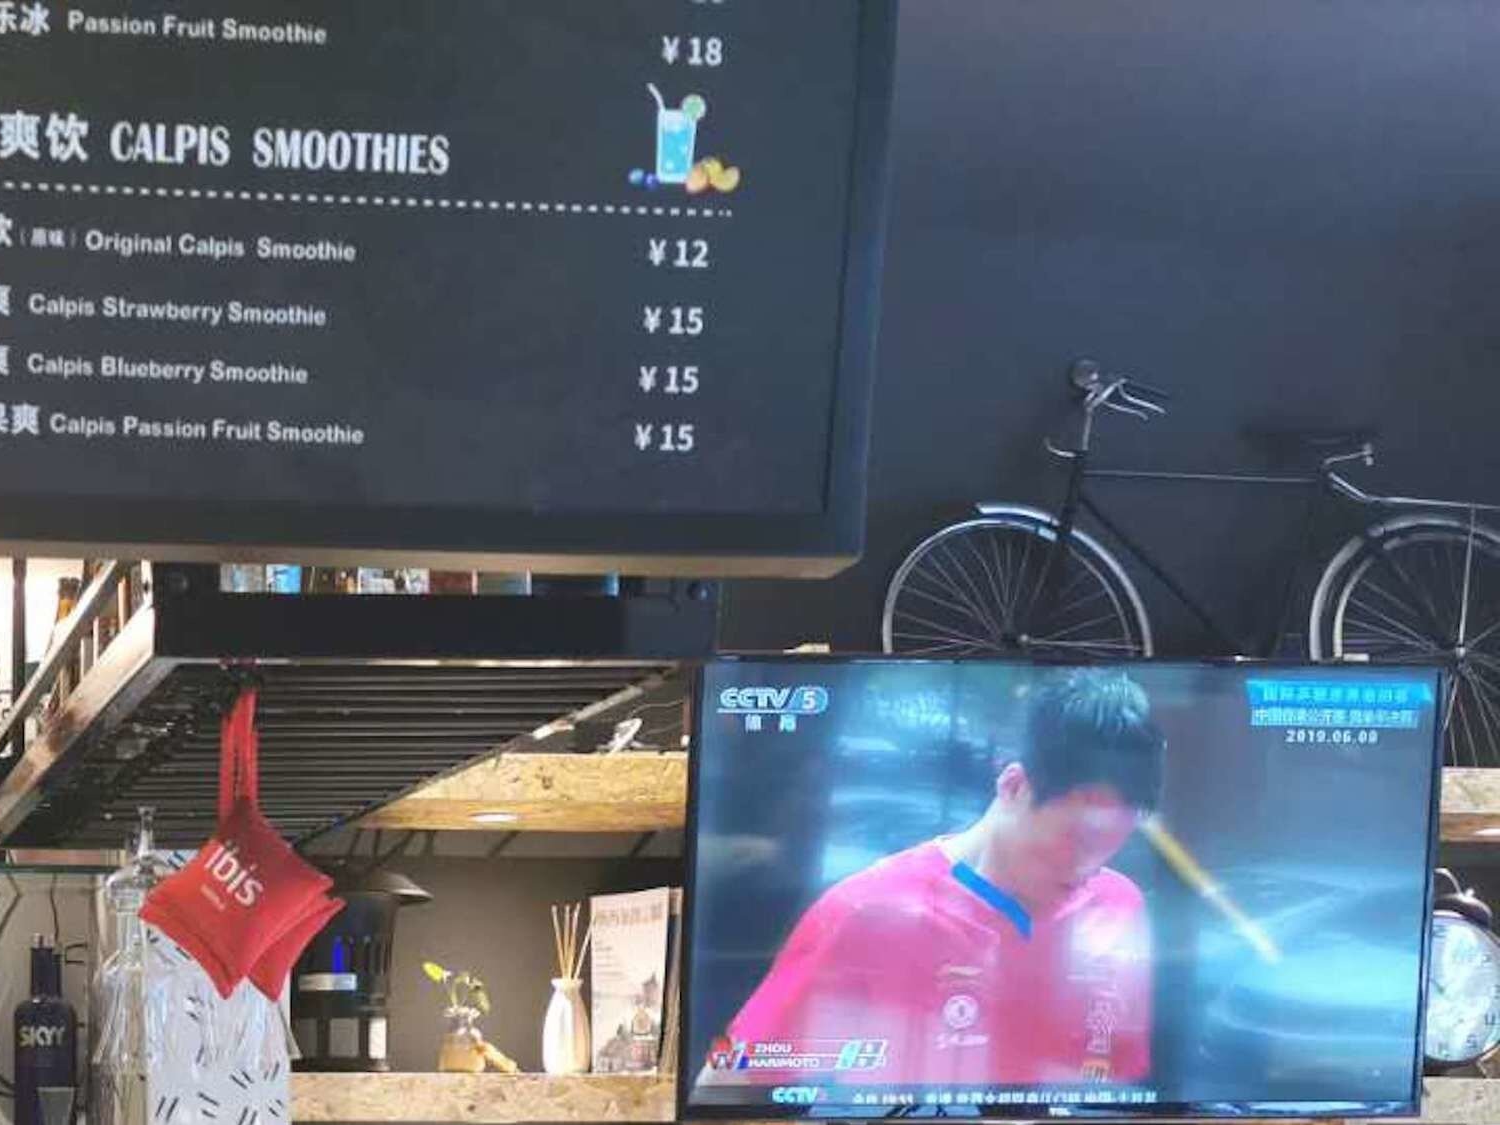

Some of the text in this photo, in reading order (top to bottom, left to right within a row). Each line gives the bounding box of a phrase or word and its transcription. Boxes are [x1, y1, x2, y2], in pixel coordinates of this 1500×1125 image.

[67, 9, 156, 35] Passion
[162, 15, 215, 39] Fruit
[221, 18, 328, 44] Smoothie
[109, 120, 231, 167] CALPIS
[252, 127, 451, 176] SMOOTHIES
[84, 228, 173, 257] Original
[177, 232, 245, 261] Calpis
[256, 236, 357, 262] Smoothie
[28, 292, 95, 319] Calpis
[102, 295, 222, 326] Strawberry
[228, 301, 326, 326] Smoothie
[26, 352, 93, 379] Calpis
[99, 354, 204, 384] Blueberry
[209, 360, 309, 384] Smoothie
[49, 412, 116, 439] Calpis
[122, 415, 207, 440] Passion
[211, 418, 263, 442] Fruit
[266, 420, 365, 445] Smoothie
[203, 838, 265, 907] ibis
